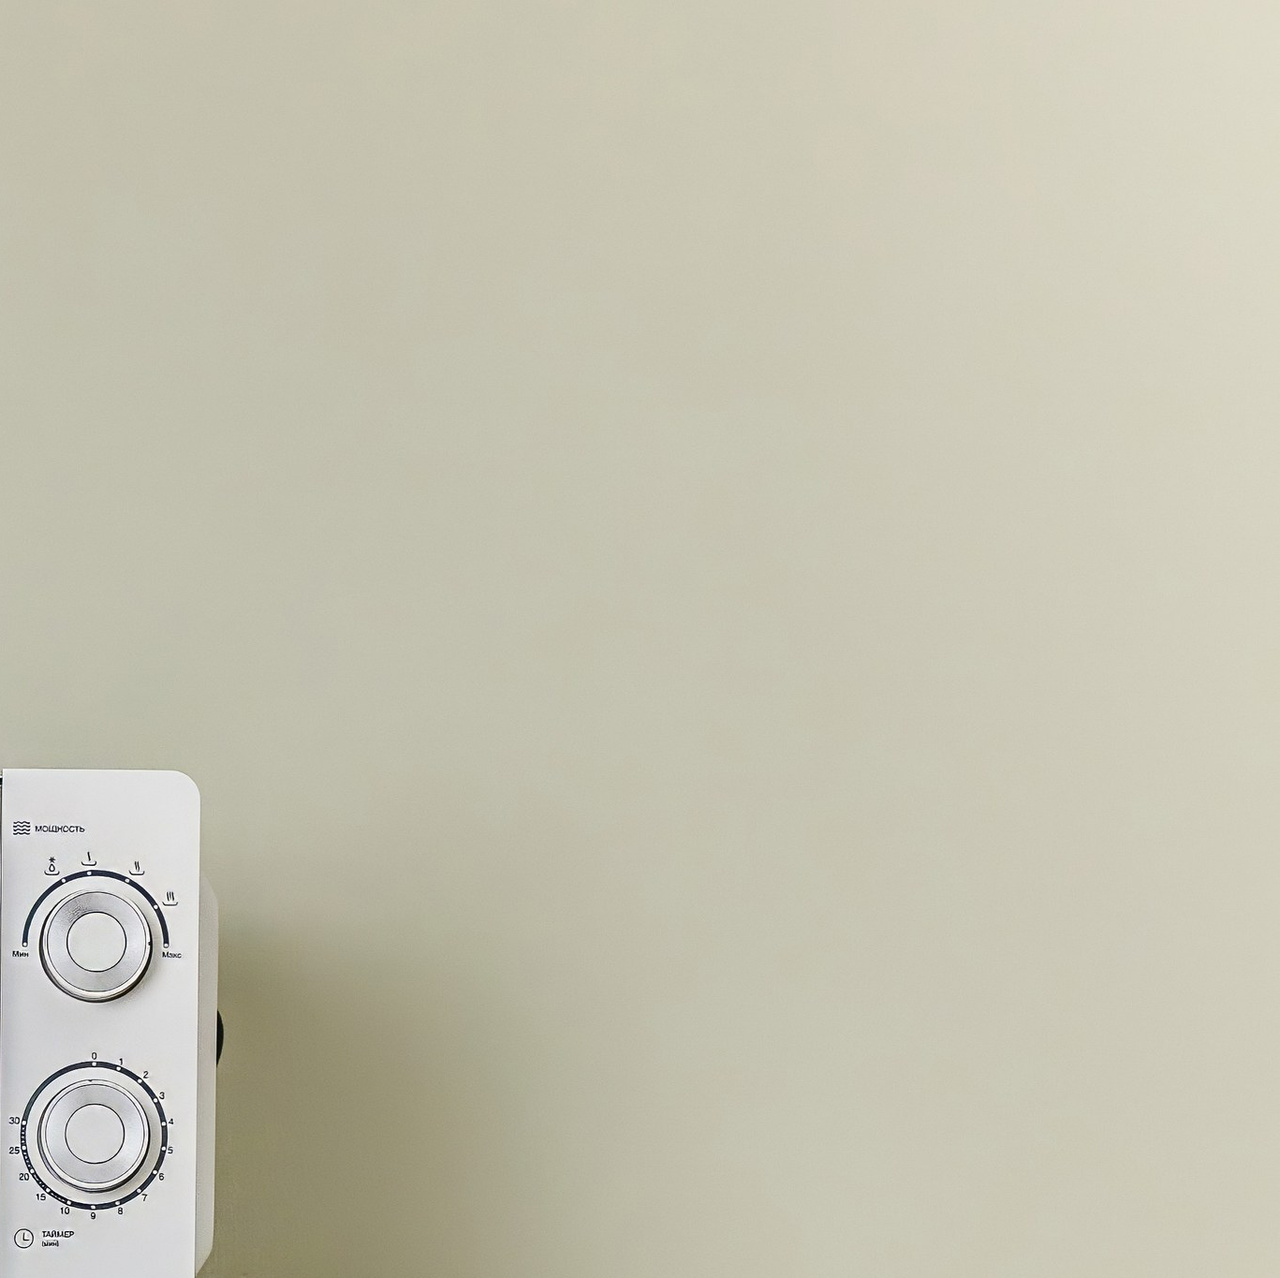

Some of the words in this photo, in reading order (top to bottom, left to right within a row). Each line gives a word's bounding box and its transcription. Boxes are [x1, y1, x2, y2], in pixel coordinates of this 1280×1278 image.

[91, 1052, 98, 1060] 0
[119, 1058, 124, 1066] 1
[143, 1071, 149, 1079] 2
[159, 1092, 165, 1100] 3
[8, 1116, 20, 1125] 30
[8, 1146, 20, 1155] 25
[167, 1146, 174, 1155] 5
[19, 1172, 30, 1181] 20
[158, 1172, 165, 1181] 6
[36, 1192, 47, 1201] 15
[142, 1193, 148, 1202] 7
[60, 1206, 70, 1215] 10
[117, 1206, 124, 1215] 8
[90, 1212, 96, 1220] 9
